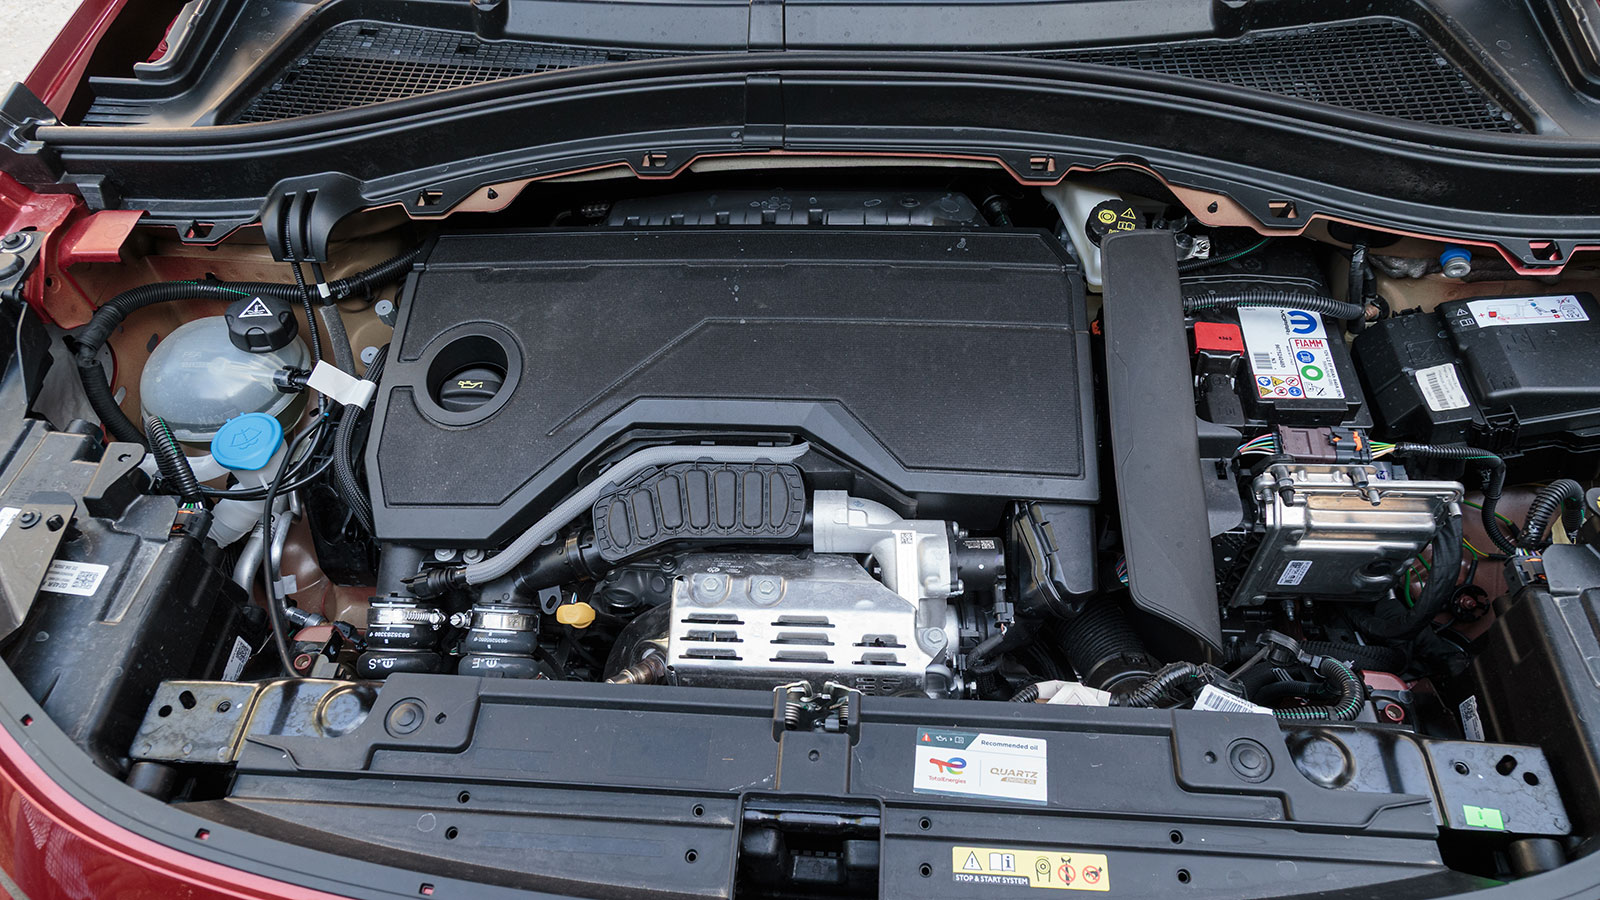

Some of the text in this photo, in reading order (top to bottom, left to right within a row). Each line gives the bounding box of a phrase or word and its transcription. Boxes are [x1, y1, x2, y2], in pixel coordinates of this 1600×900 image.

[1294, 339, 1324, 348] FIAMM
[981, 740, 1029, 750] Recommended
[990, 767, 1039, 779] QUARTZ
[928, 775, 967, 785] TotalEnergies
[955, 874, 974, 882] STOP
[980, 875, 1001, 883] START
[1002, 877, 1028, 885] SYSTEM
